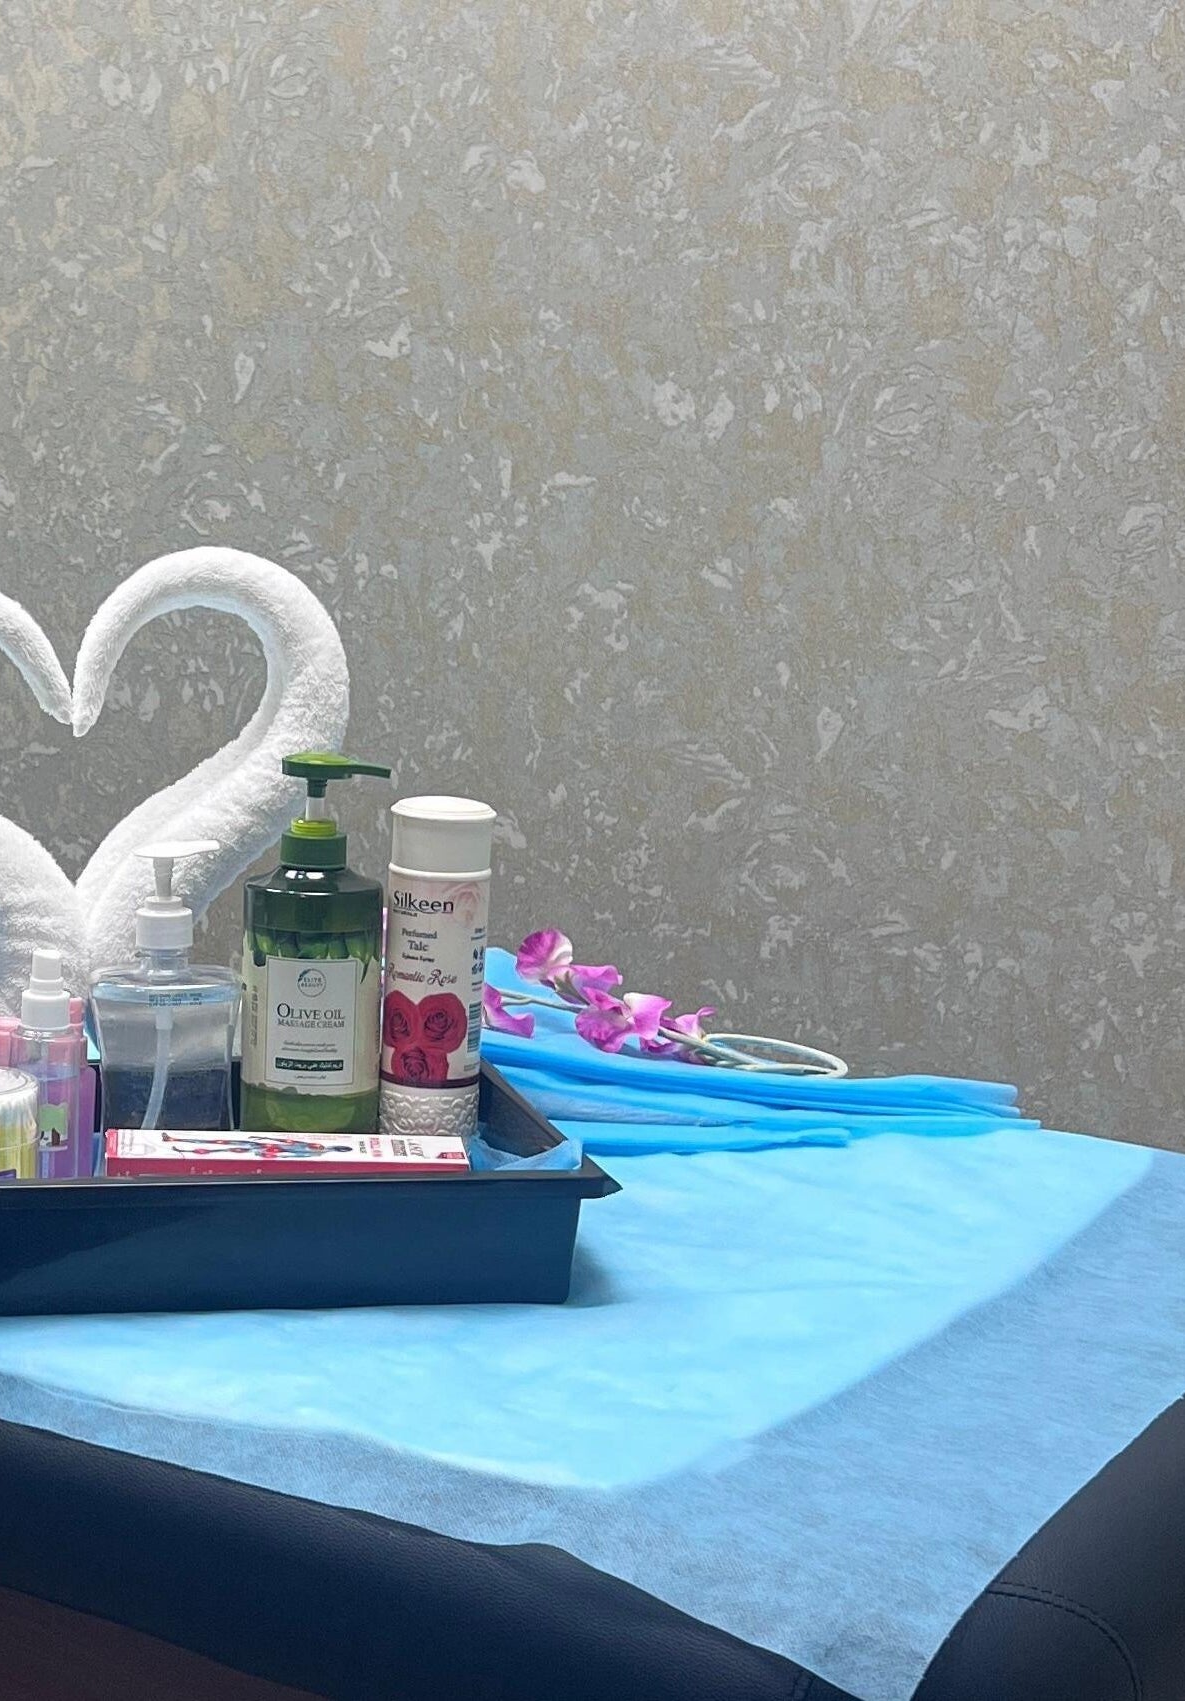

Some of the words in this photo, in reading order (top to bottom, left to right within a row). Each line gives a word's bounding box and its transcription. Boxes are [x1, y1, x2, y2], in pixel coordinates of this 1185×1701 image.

[393, 890, 455, 914] Silkeen
[407, 940, 429, 951] Talc
[427, 968, 457, 987] Rose
[277, 1002, 321, 1020] OLIVE
[323, 1009, 346, 1020] OIL
[277, 1019, 316, 1028] MASSAGE
[317, 1020, 345, 1029] CREAM
